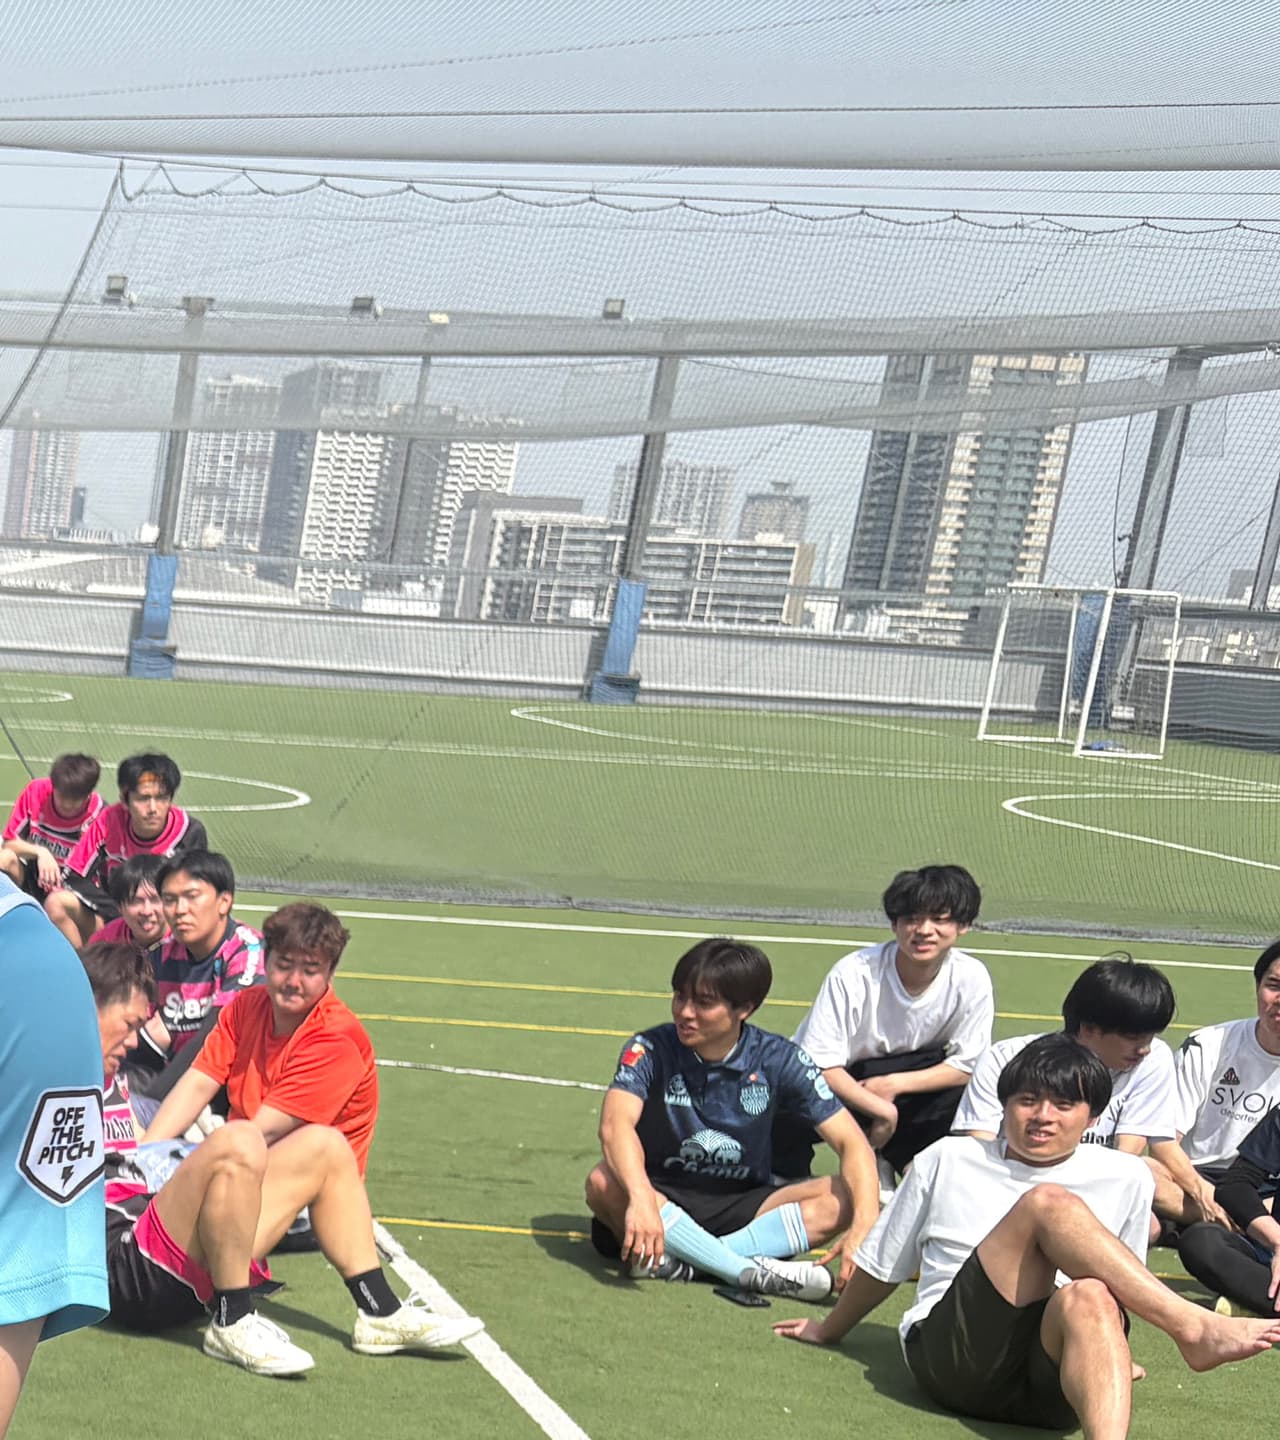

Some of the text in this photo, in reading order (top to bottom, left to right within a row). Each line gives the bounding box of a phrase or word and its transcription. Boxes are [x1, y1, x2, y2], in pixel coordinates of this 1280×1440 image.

[52, 1106, 86, 1126] OFF
[49, 1124, 85, 1146] THE
[37, 1140, 96, 1165] PITCH
